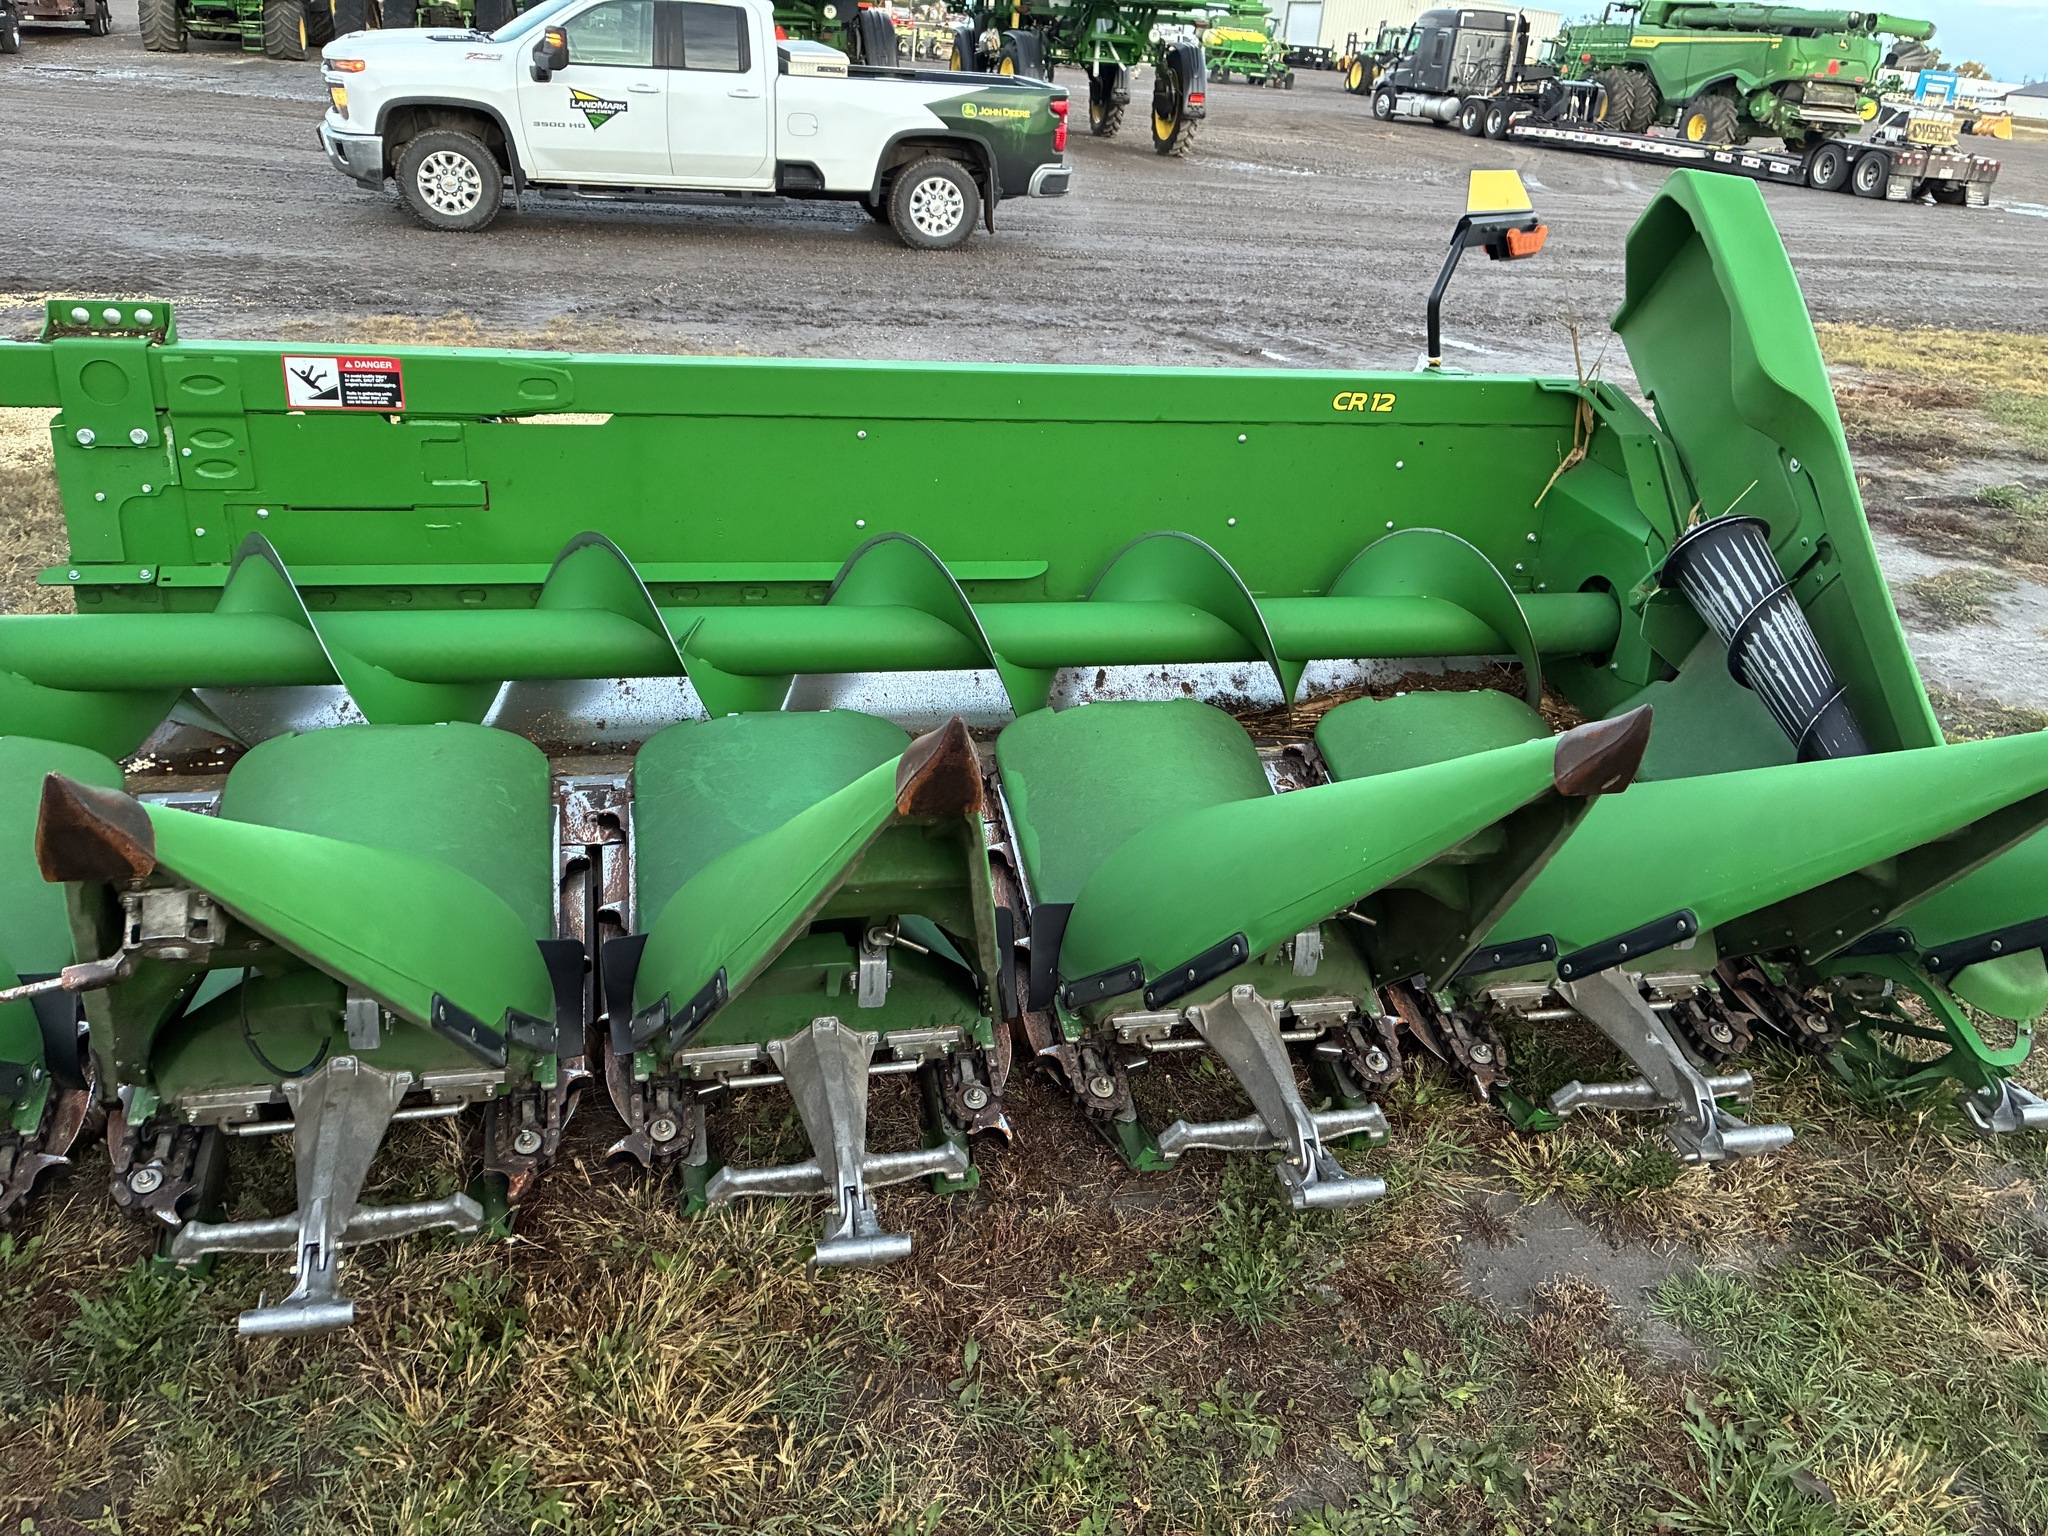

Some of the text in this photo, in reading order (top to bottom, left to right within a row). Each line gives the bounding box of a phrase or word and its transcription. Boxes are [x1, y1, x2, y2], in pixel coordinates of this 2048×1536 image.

[572, 100, 626, 110] LANDMARK
[979, 106, 1030, 118] JOHN DEERE
[1332, 390, 1397, 413] CR 12
